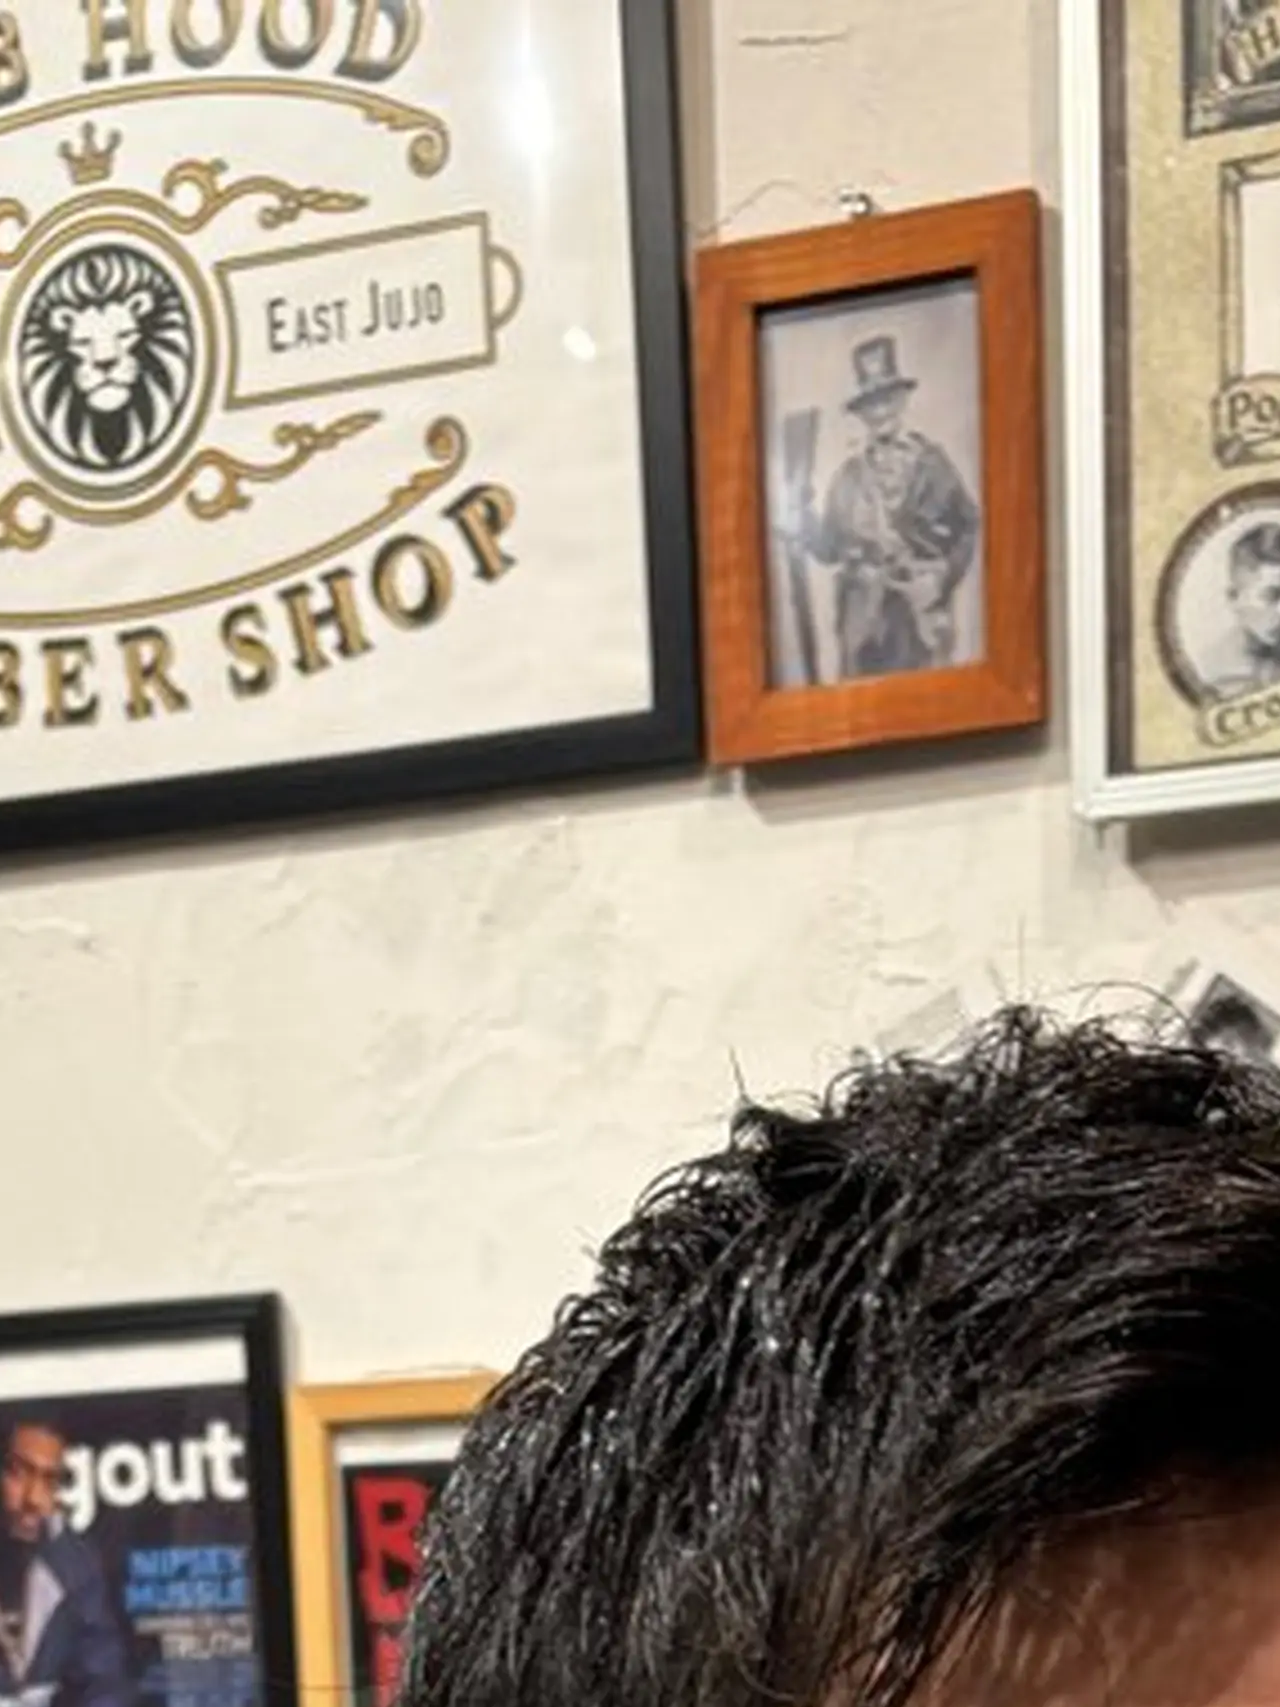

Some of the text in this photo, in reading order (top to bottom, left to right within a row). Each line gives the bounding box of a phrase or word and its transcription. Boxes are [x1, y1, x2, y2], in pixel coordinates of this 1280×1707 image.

[80, 0, 422, 82] HOOD
[266, 279, 444, 352] EAST JUJO
[220, 483, 517, 698] SHOP
